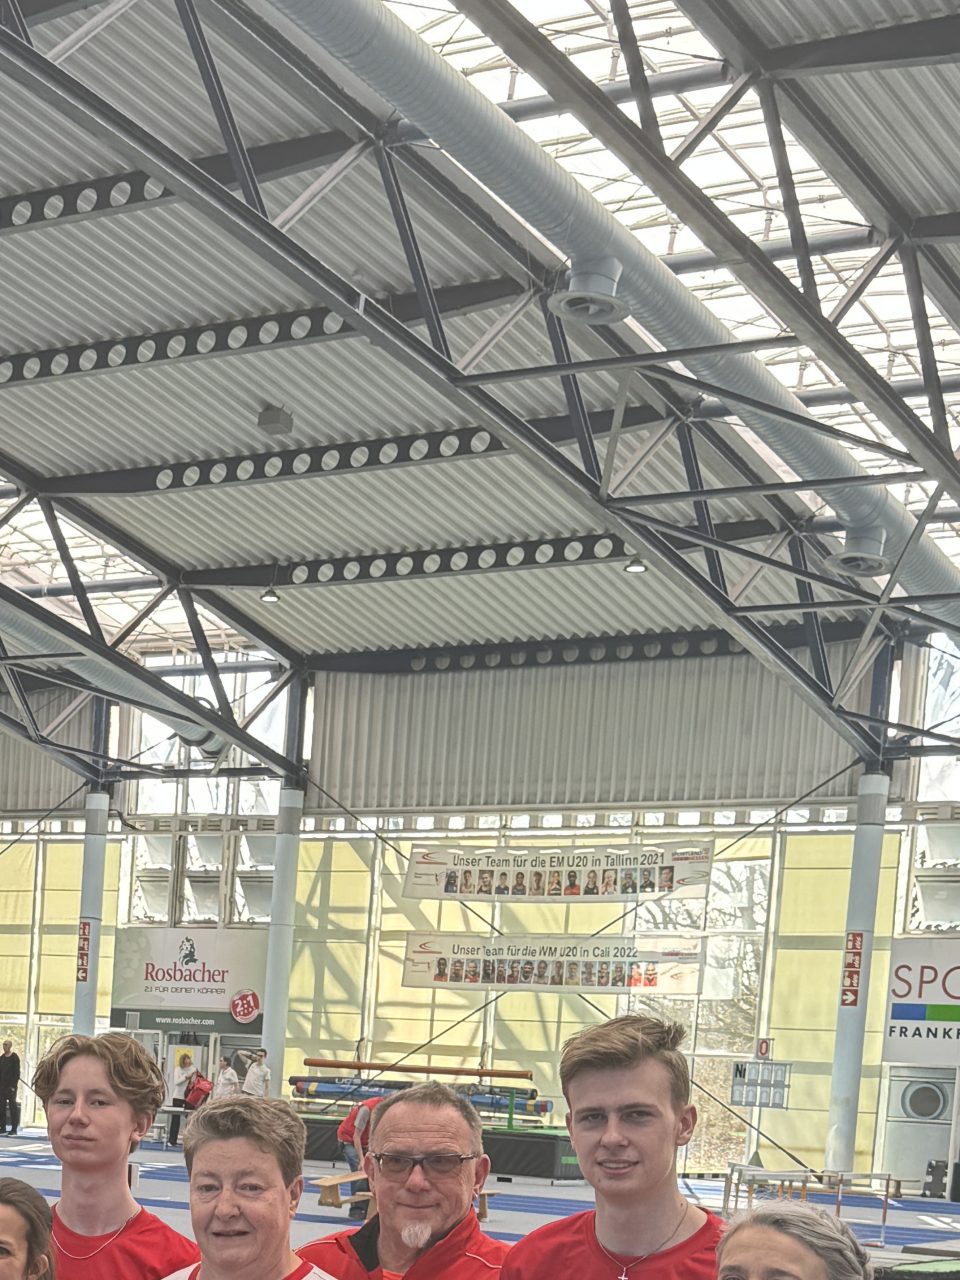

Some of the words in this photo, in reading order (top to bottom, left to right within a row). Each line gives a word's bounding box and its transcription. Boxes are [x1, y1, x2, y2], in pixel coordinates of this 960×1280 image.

[453, 855, 482, 866] Unser
[485, 856, 510, 867] Team
[513, 856, 527, 867] für
[530, 856, 546, 867] die
[550, 856, 564, 868] EM
[567, 856, 588, 867] U20
[592, 856, 601, 866] in
[605, 854, 638, 866] Tallinn
[640, 852, 664, 866] 2021
[452, 944, 480, 955] Unser
[507, 945, 520, 956] für
[522, 946, 536, 957] die
[580, 946, 589, 957] in
[592, 947, 609, 957] Cali
[613, 947, 638, 957] 2022
[144, 961, 229, 983] Rosbacher
[234, 995, 254, 1012] 2:1
[156, 1016, 214, 1025] www.rosbacher.com
